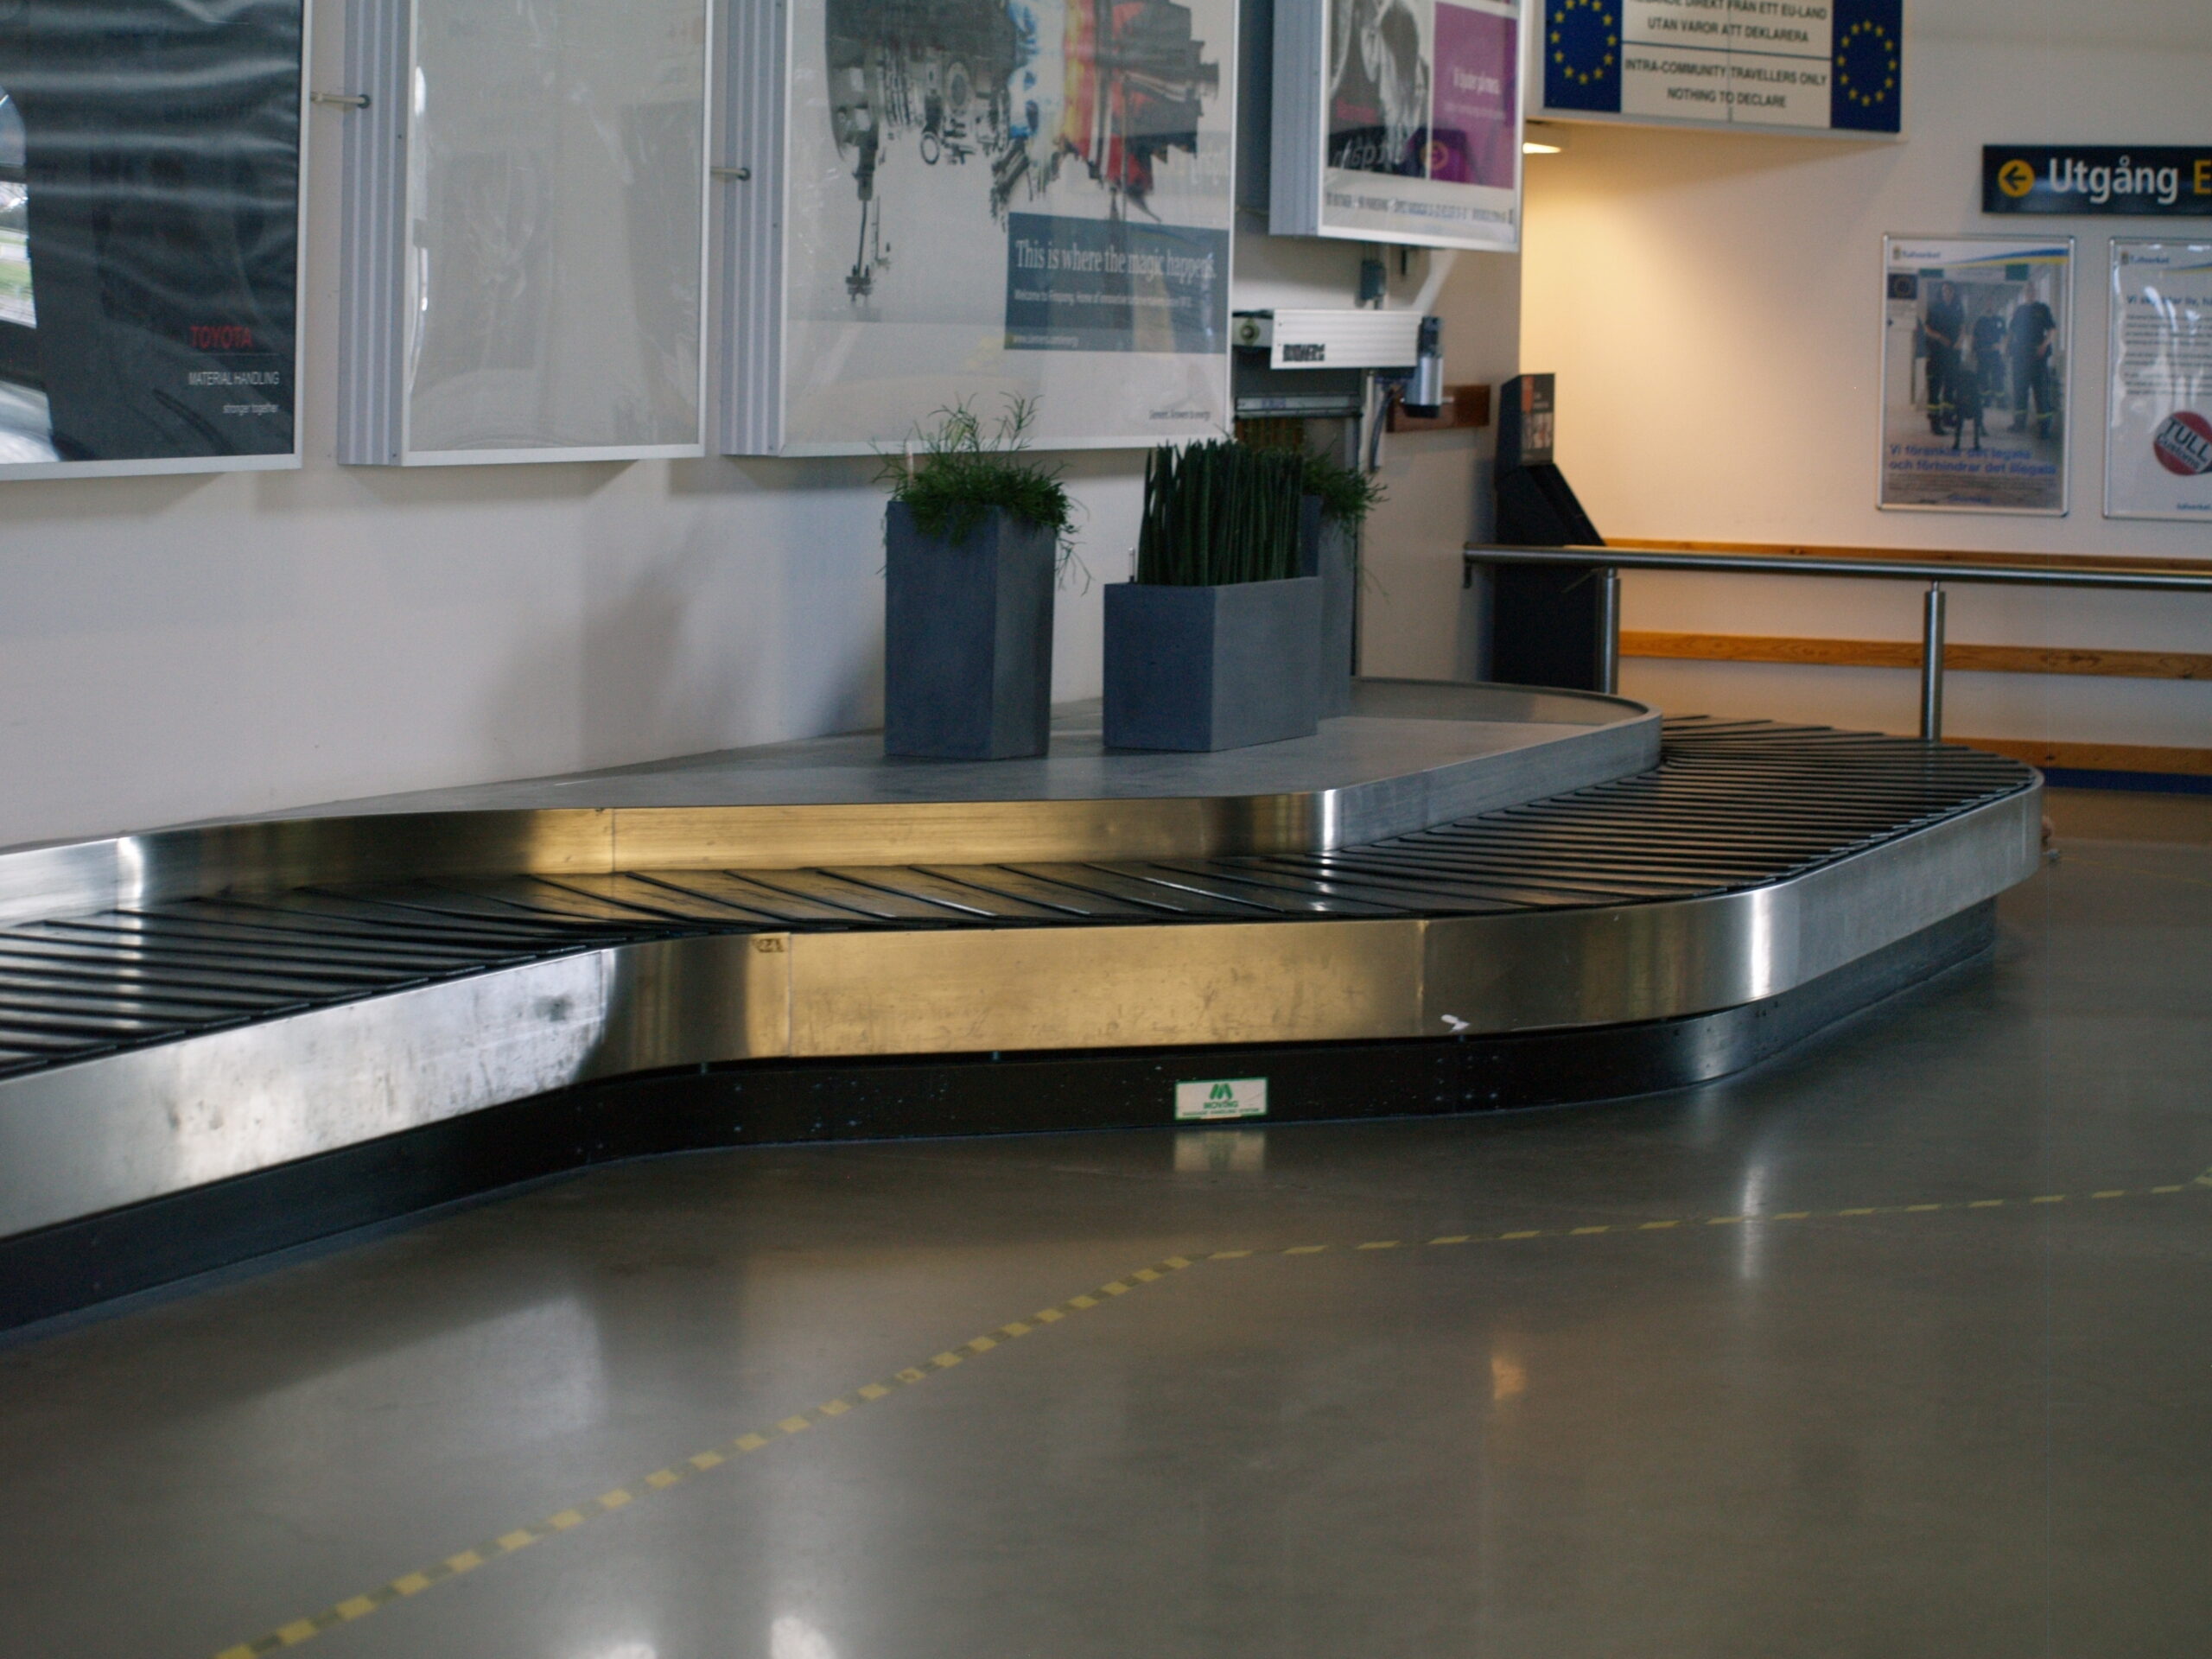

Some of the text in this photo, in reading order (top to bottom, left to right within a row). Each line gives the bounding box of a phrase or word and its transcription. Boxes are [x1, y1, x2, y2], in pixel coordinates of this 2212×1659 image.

[1648, 16, 1809, 42] UTAN VAROR ATT DEKLARERA
[1624, 59, 1827, 86] INTRA-COMMUNITY TRAVELLERS ONLY
[1667, 87, 1787, 108] NOTHING TO DECLARE
[2049, 155, 2178, 204] Utgång
[1016, 239, 1045, 269] This
[1047, 241, 1058, 270] is
[1061, 243, 1103, 272] where
[1104, 244, 1125, 274] the
[1128, 248, 1164, 283] magic
[189, 325, 253, 349] TOYOTA
[188, 371, 280, 385] MATERIAL HANDLING
[2164, 415, 2209, 464] TULL
